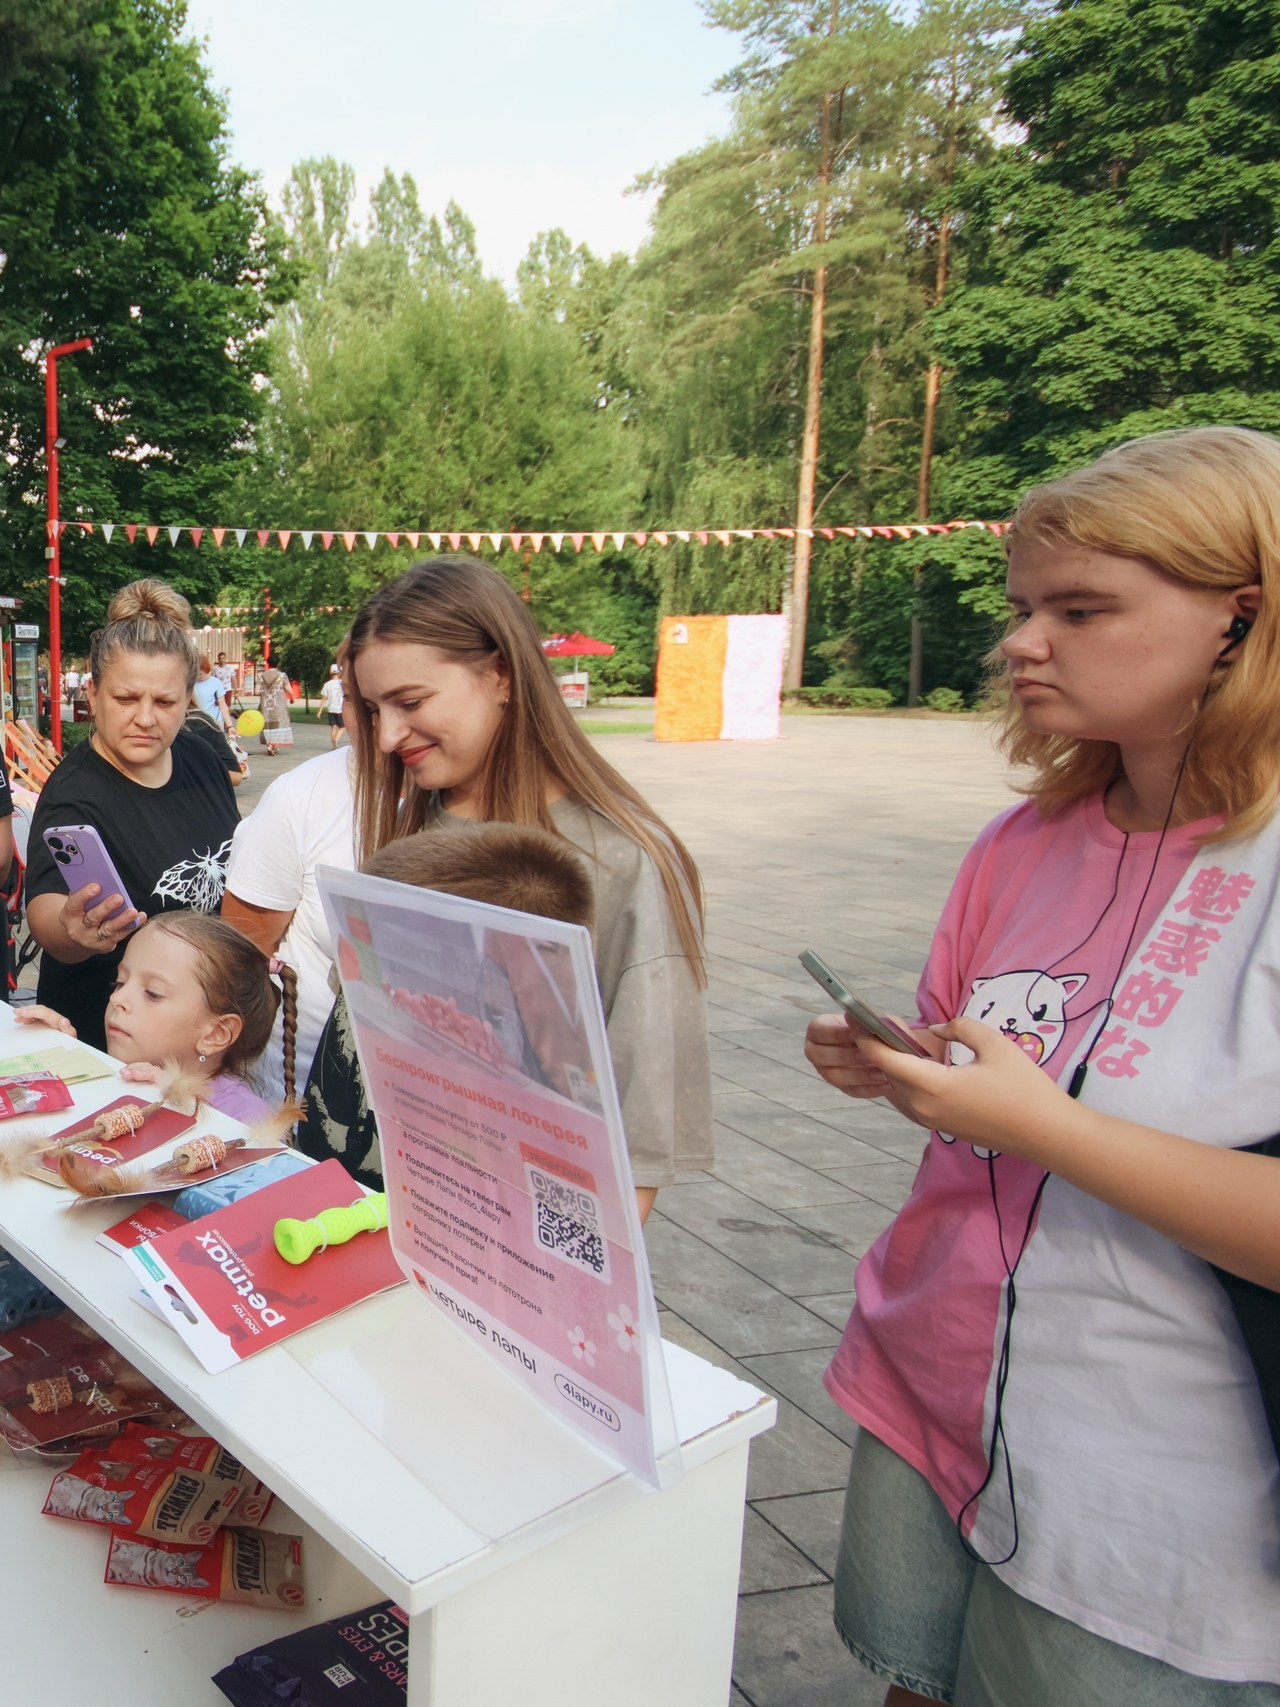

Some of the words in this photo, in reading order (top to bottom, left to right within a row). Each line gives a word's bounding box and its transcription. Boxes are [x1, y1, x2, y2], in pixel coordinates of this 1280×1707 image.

[1084, 865, 1256, 1080] 魅惑的な
[376, 1047, 507, 1115] Беспроигрышная
[511, 1108, 588, 1150] лотерея
[408, 1133, 450, 1161] программе
[450, 1150, 499, 1184] лояльности
[405, 1153, 460, 1188] Подпишитесь
[460, 1184, 471, 1194] на
[471, 1188, 512, 1218] телеграм
[407, 1165, 435, 1187] Четыре
[436, 1181, 457, 1198] Лапы
[211, 1228, 243, 1264] professional
[410, 1188, 449, 1216] Покажите
[449, 1212, 489, 1243] подписку
[489, 1236, 496, 1246] и
[497, 1241, 555, 1282] приложение
[412, 1202, 452, 1235] сотруднику
[453, 1228, 485, 1252] лотереи
[195, 1230, 287, 1328] petmax
[240, 1260, 256, 1278] pets
[413, 1224, 449, 1254] Вытащите
[450, 1249, 486, 1277] талончик
[487, 1273, 497, 1285] из
[498, 1279, 543, 1316] лототрона
[420, 1243, 455, 1270] получите
[455, 1265, 479, 1286] приз!
[231, 1303, 245, 1320] TOY
[243, 1318, 261, 1336] DOG
[429, 1284, 487, 1336] четыре
[491, 1329, 537, 1374] лапы
[68, 1365, 118, 1415] pemax
[562, 1382, 613, 1424] 4lapy.ru
[338, 1626, 375, 1653] EYES
[368, 1650, 386, 1662] &
[328, 1669, 345, 1686] PUR
[334, 1665, 352, 1682] FUR
[380, 1661, 408, 1694] ARS
